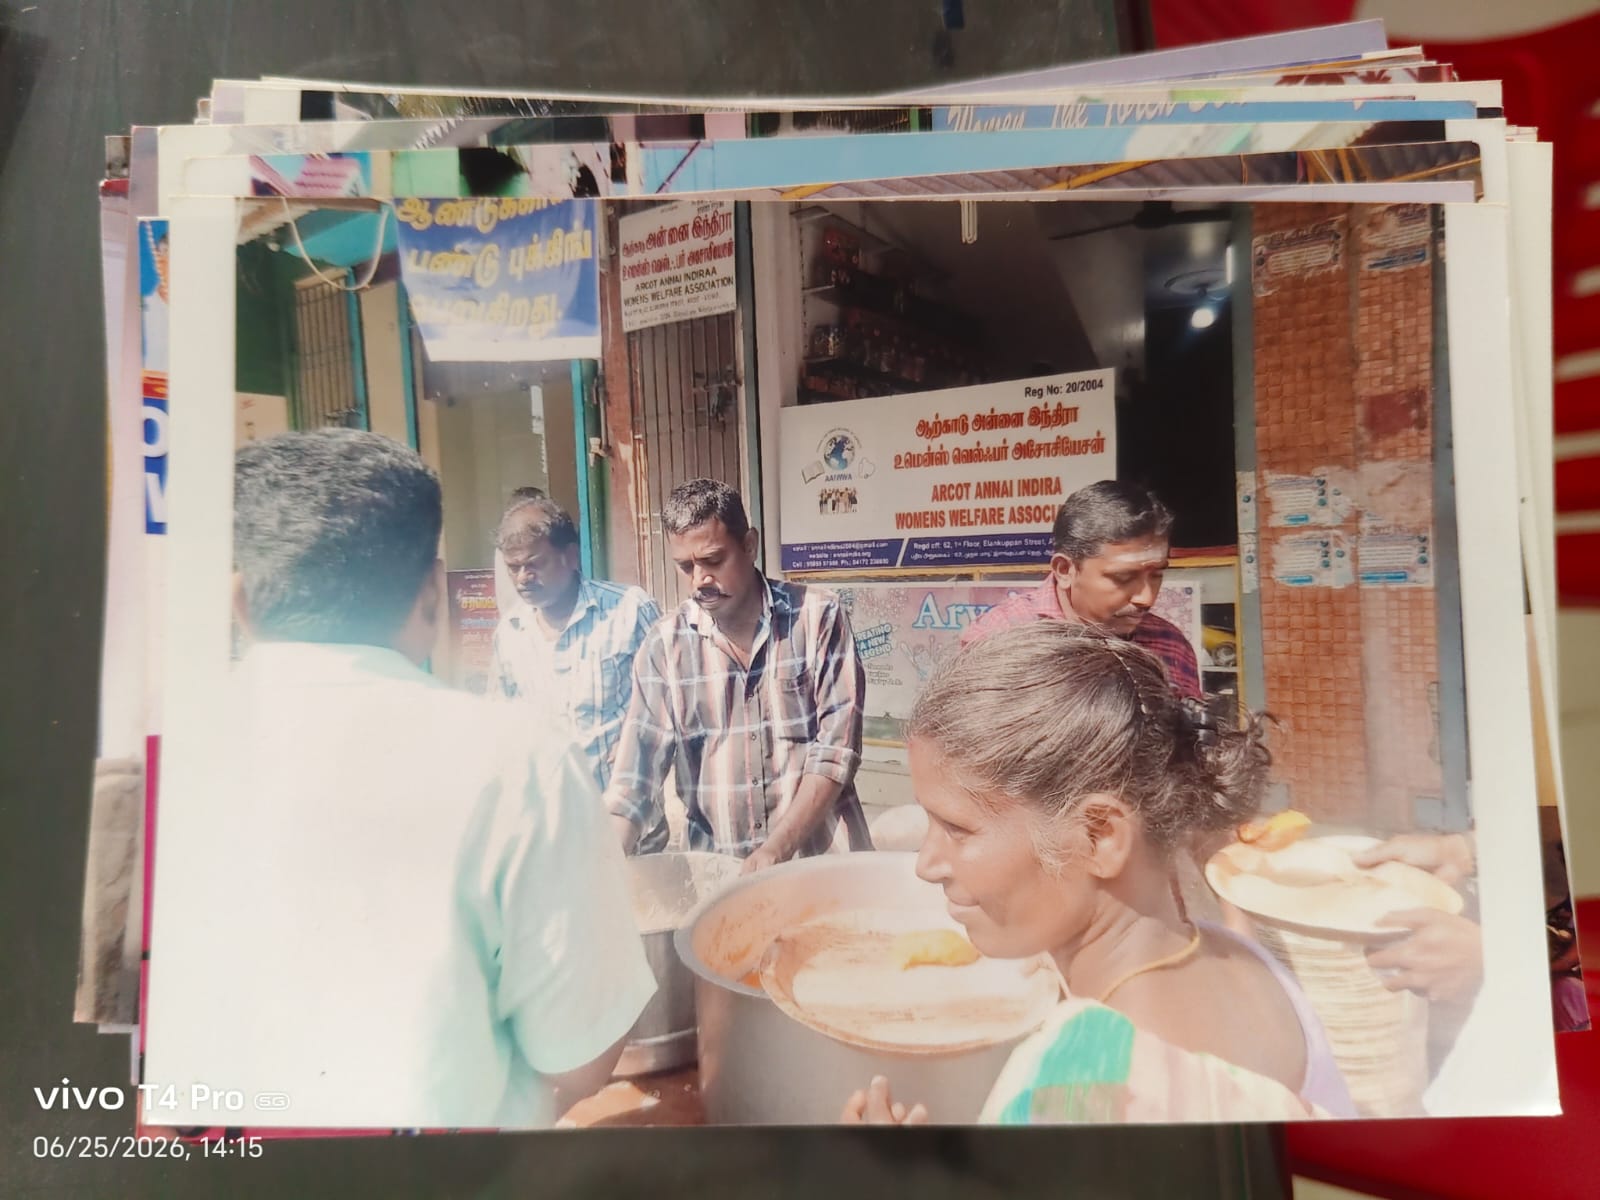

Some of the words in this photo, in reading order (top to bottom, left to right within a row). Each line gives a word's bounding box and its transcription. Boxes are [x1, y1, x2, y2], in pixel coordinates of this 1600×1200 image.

[624, 294, 649, 307] WOMENS
[651, 286, 683, 302] WELFARE
[684, 276, 734, 296] ASSOCIATION
[635, 279, 658, 292] ARCOT
[660, 274, 683, 287] ANNAI
[683, 266, 717, 281] INDIRAA
[1025, 386, 1044, 399] Reg
[1047, 385, 1063, 396] No:
[1066, 379, 1104, 394] 20/2004
[915, 413, 969, 441] ஆற்காடு
[971, 408, 1024, 431] அன்னை
[1027, 401, 1079, 430] இந்திரா
[931, 482, 971, 502] ARCOT
[974, 480, 1014, 501] ANNAI
[1017, 477, 1062, 498] INDIRA
[895, 510, 946, 530] WOMENS
[949, 507, 1005, 527] WELFARE
[1008, 504, 1060, 525] ASSOCI
[912, 592, 998, 630] Arv
[856, 623, 892, 641] REATING
